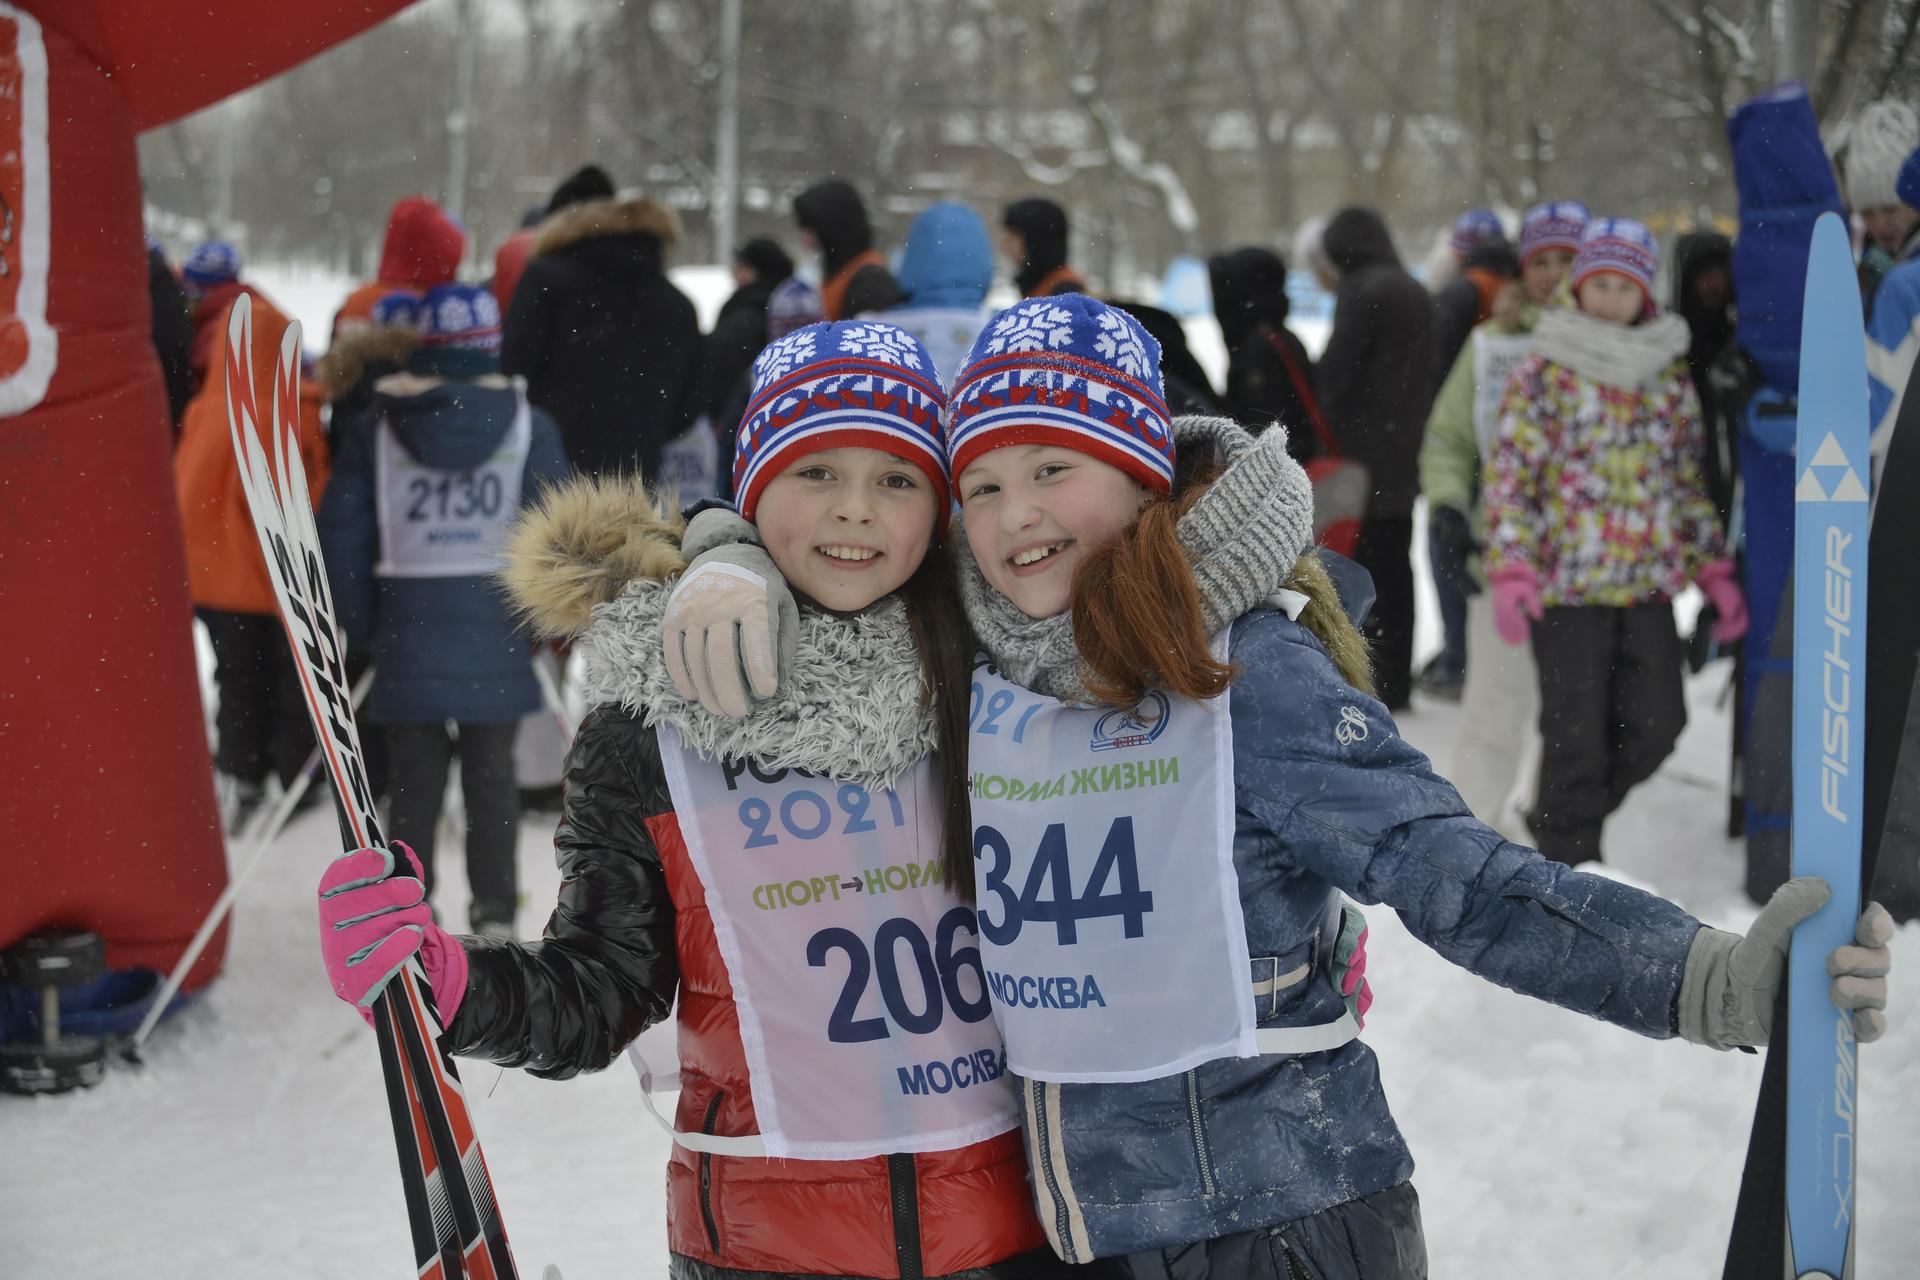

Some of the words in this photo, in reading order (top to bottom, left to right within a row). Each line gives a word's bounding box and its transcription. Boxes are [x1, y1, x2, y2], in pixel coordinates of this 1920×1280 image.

[950, 367, 1088, 433] ССИИ
[1104, 388, 1176, 463] 20
[407, 474, 503, 523] 2130
[1822, 525, 1853, 824] FISCHER
[973, 772, 1066, 802] НОРМА
[1069, 756, 1180, 797] ЖИЗНИ
[738, 783, 905, 850] 2021
[752, 873, 841, 911] СПОРТ
[863, 859, 946, 896] НОРМ
[986, 970, 1107, 1009] МОСКВА
